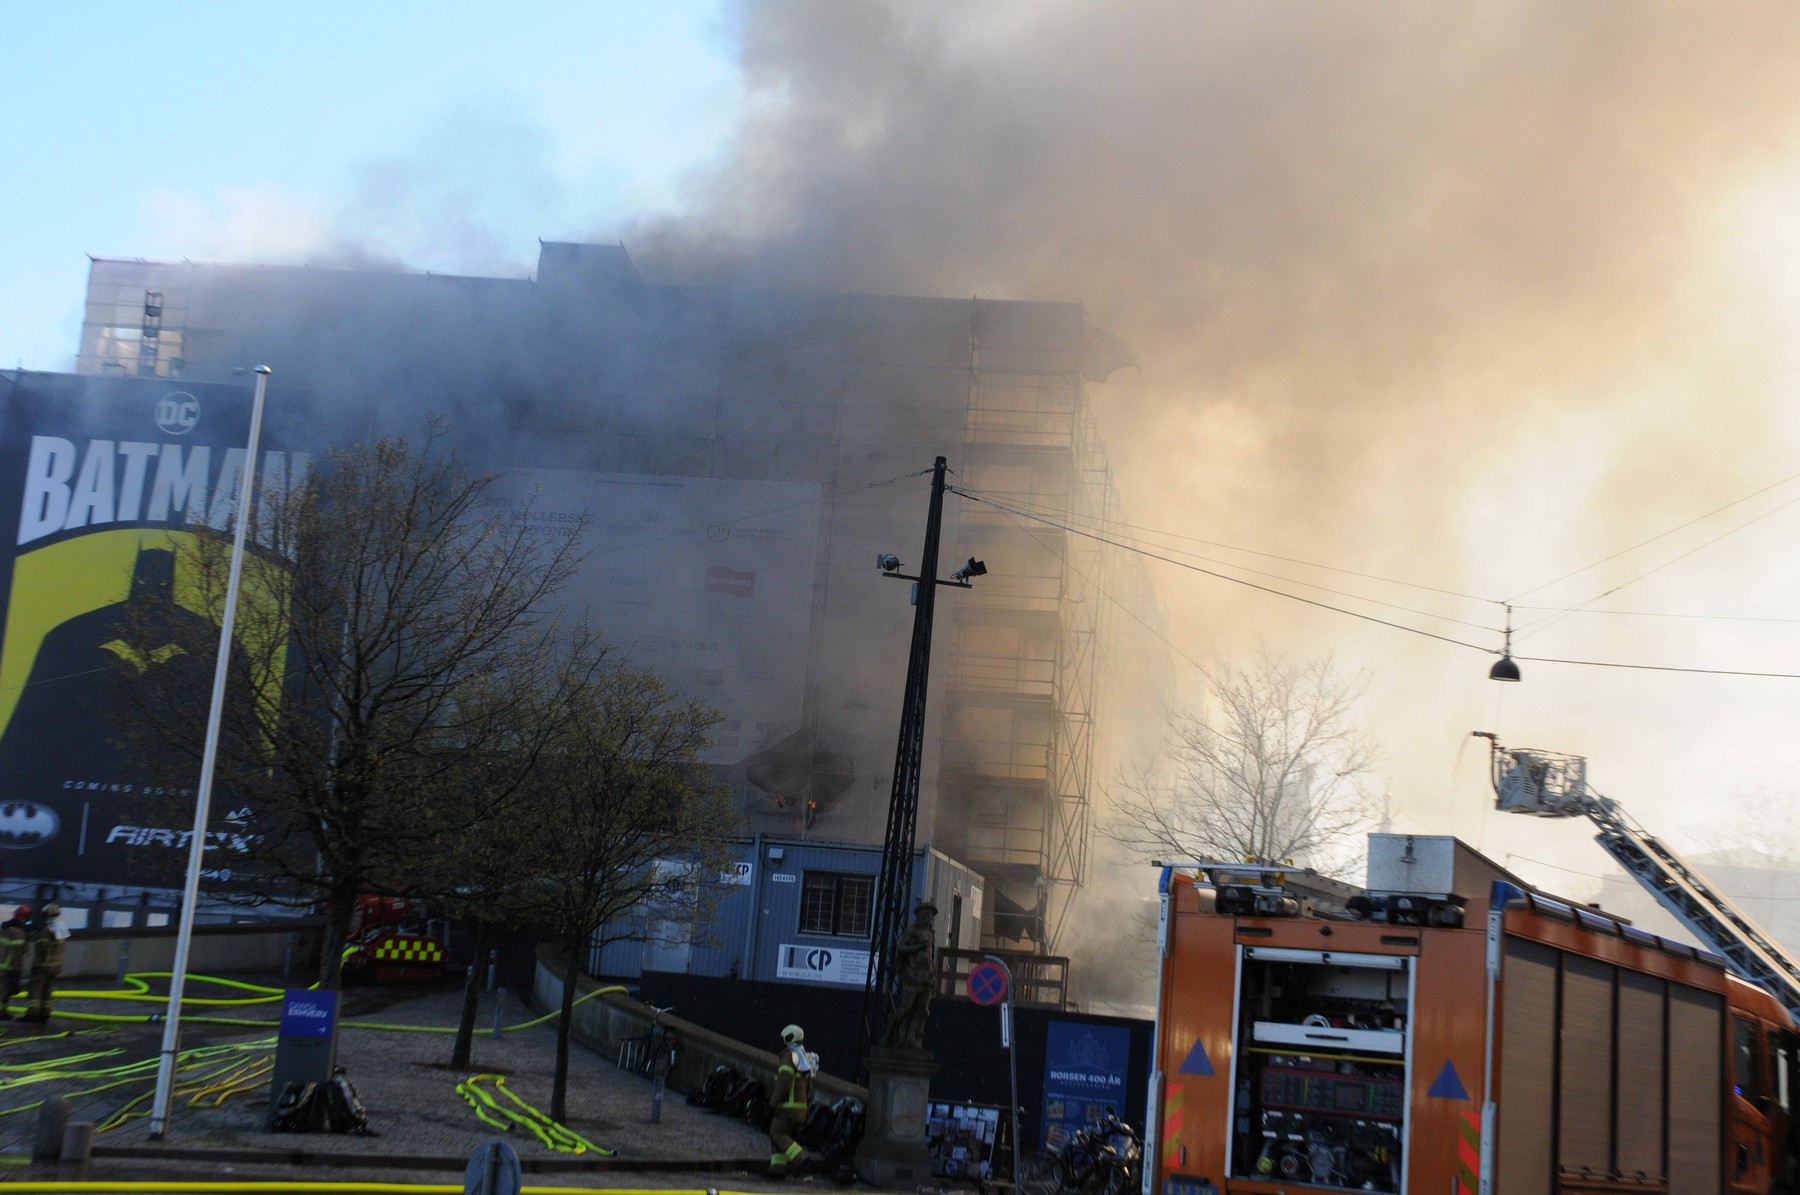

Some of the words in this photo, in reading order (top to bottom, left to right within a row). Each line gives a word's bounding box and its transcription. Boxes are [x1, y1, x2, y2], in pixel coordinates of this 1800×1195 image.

[158, 399, 199, 427] DC
[16, 435, 312, 563] BATMAN
[1088, 1074, 1107, 1084] 400
